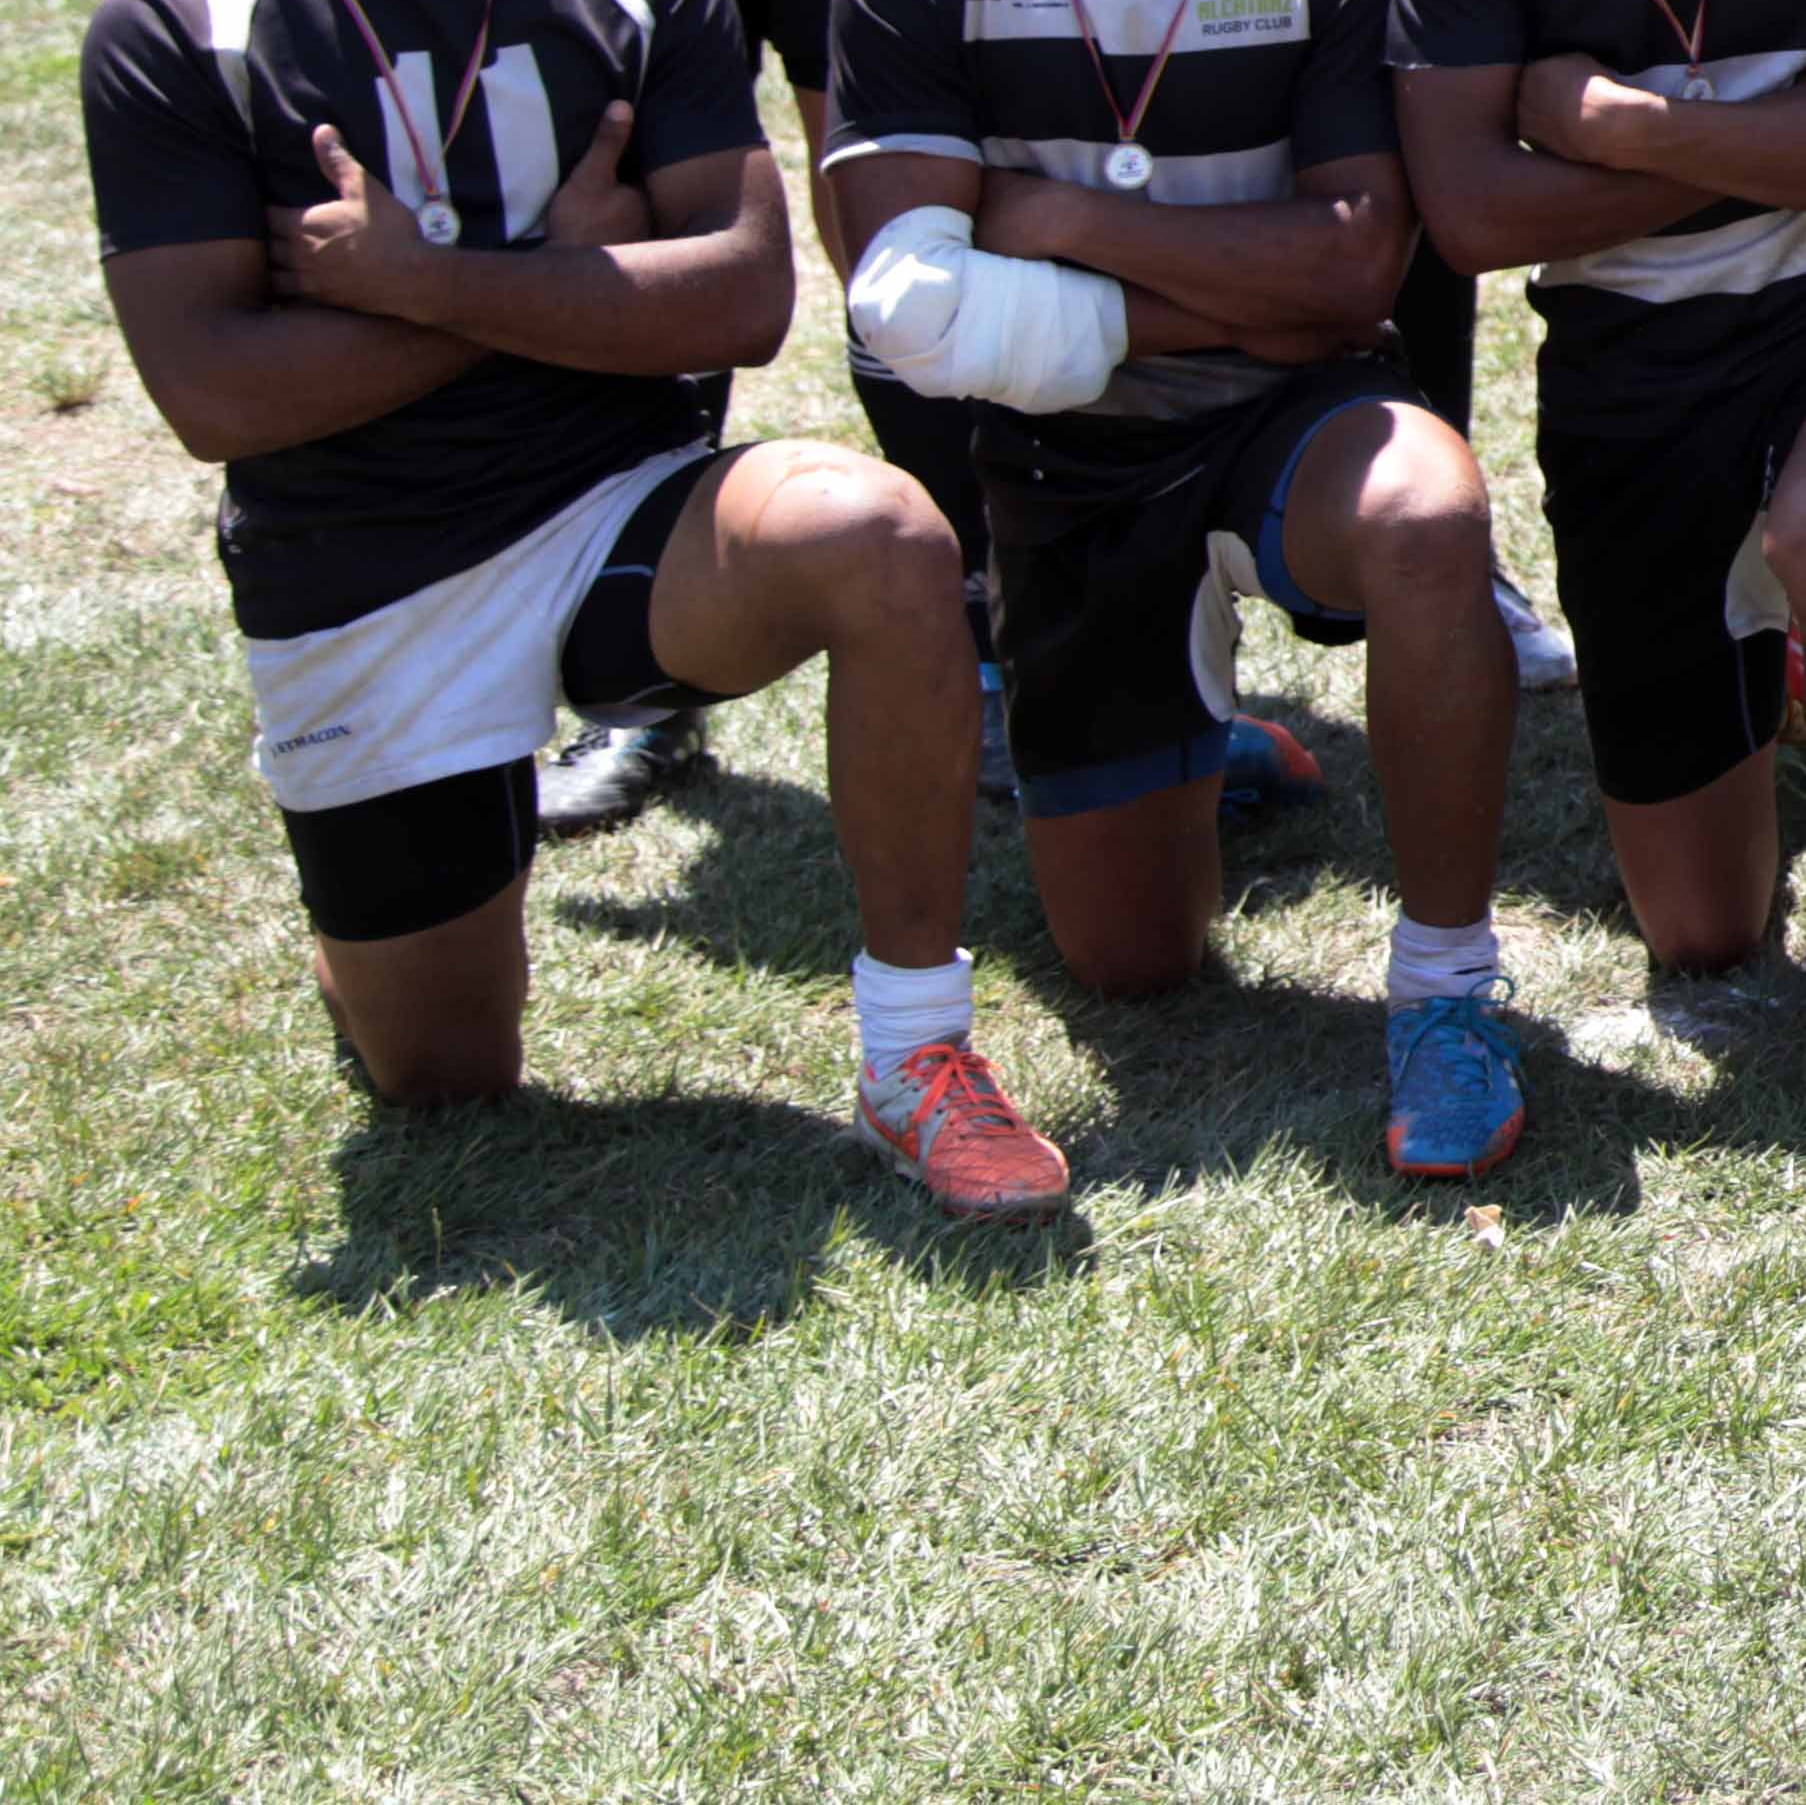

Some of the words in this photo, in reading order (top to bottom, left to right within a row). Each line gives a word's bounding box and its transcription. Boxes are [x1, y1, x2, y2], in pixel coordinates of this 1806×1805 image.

[1202, 19, 1251, 36] RUGBY
[1255, 15, 1293, 32] CLUB
[375, 43, 559, 243] 11
